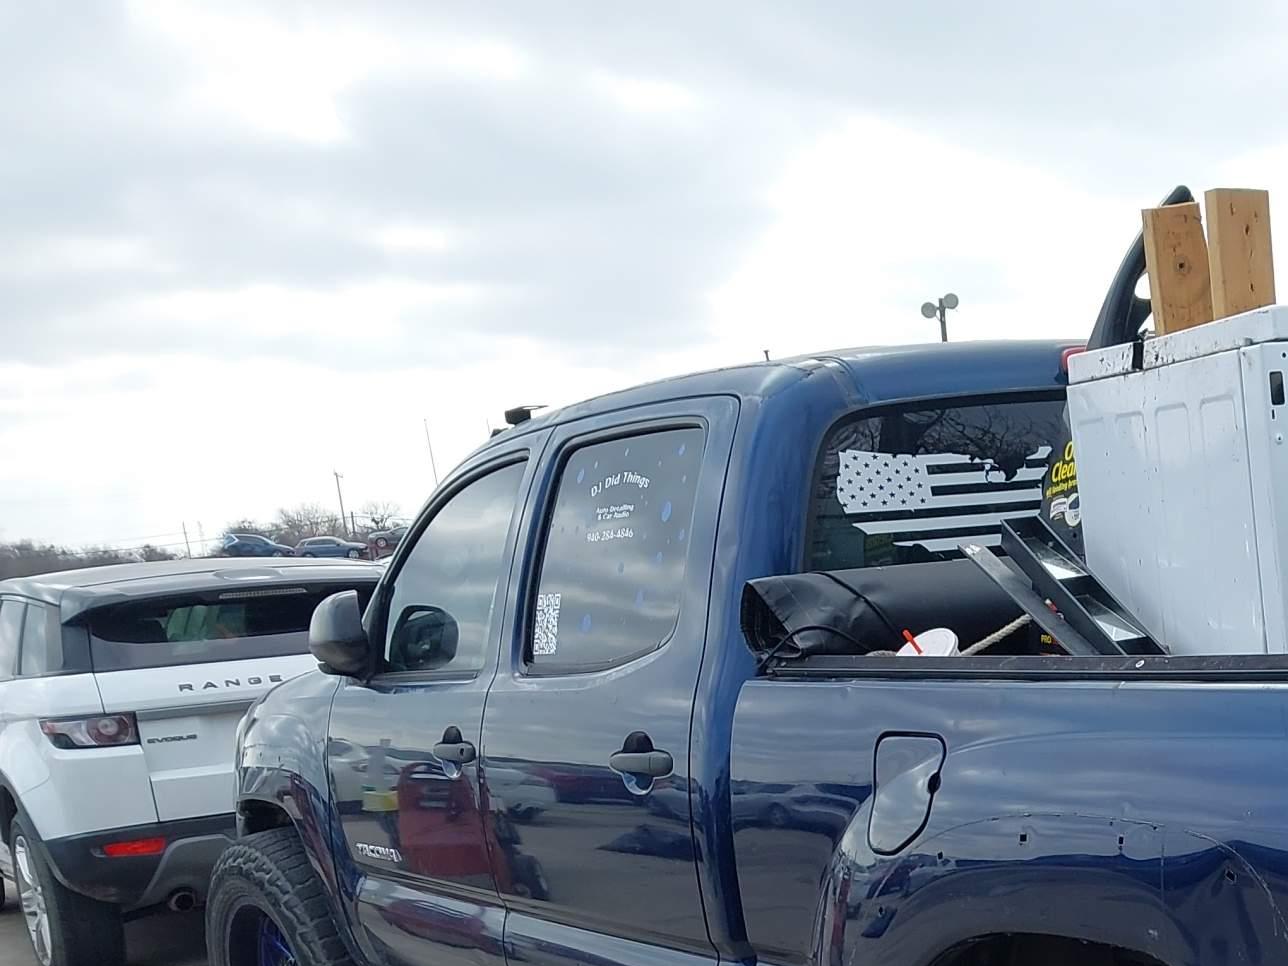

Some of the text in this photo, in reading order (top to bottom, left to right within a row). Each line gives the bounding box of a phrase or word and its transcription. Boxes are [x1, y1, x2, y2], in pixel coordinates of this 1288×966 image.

[623, 471, 650, 488] Things
[178, 674, 283, 692] RANGE
[147, 734, 198, 744] EVOQUE
[356, 843, 402, 862] TACOMA
